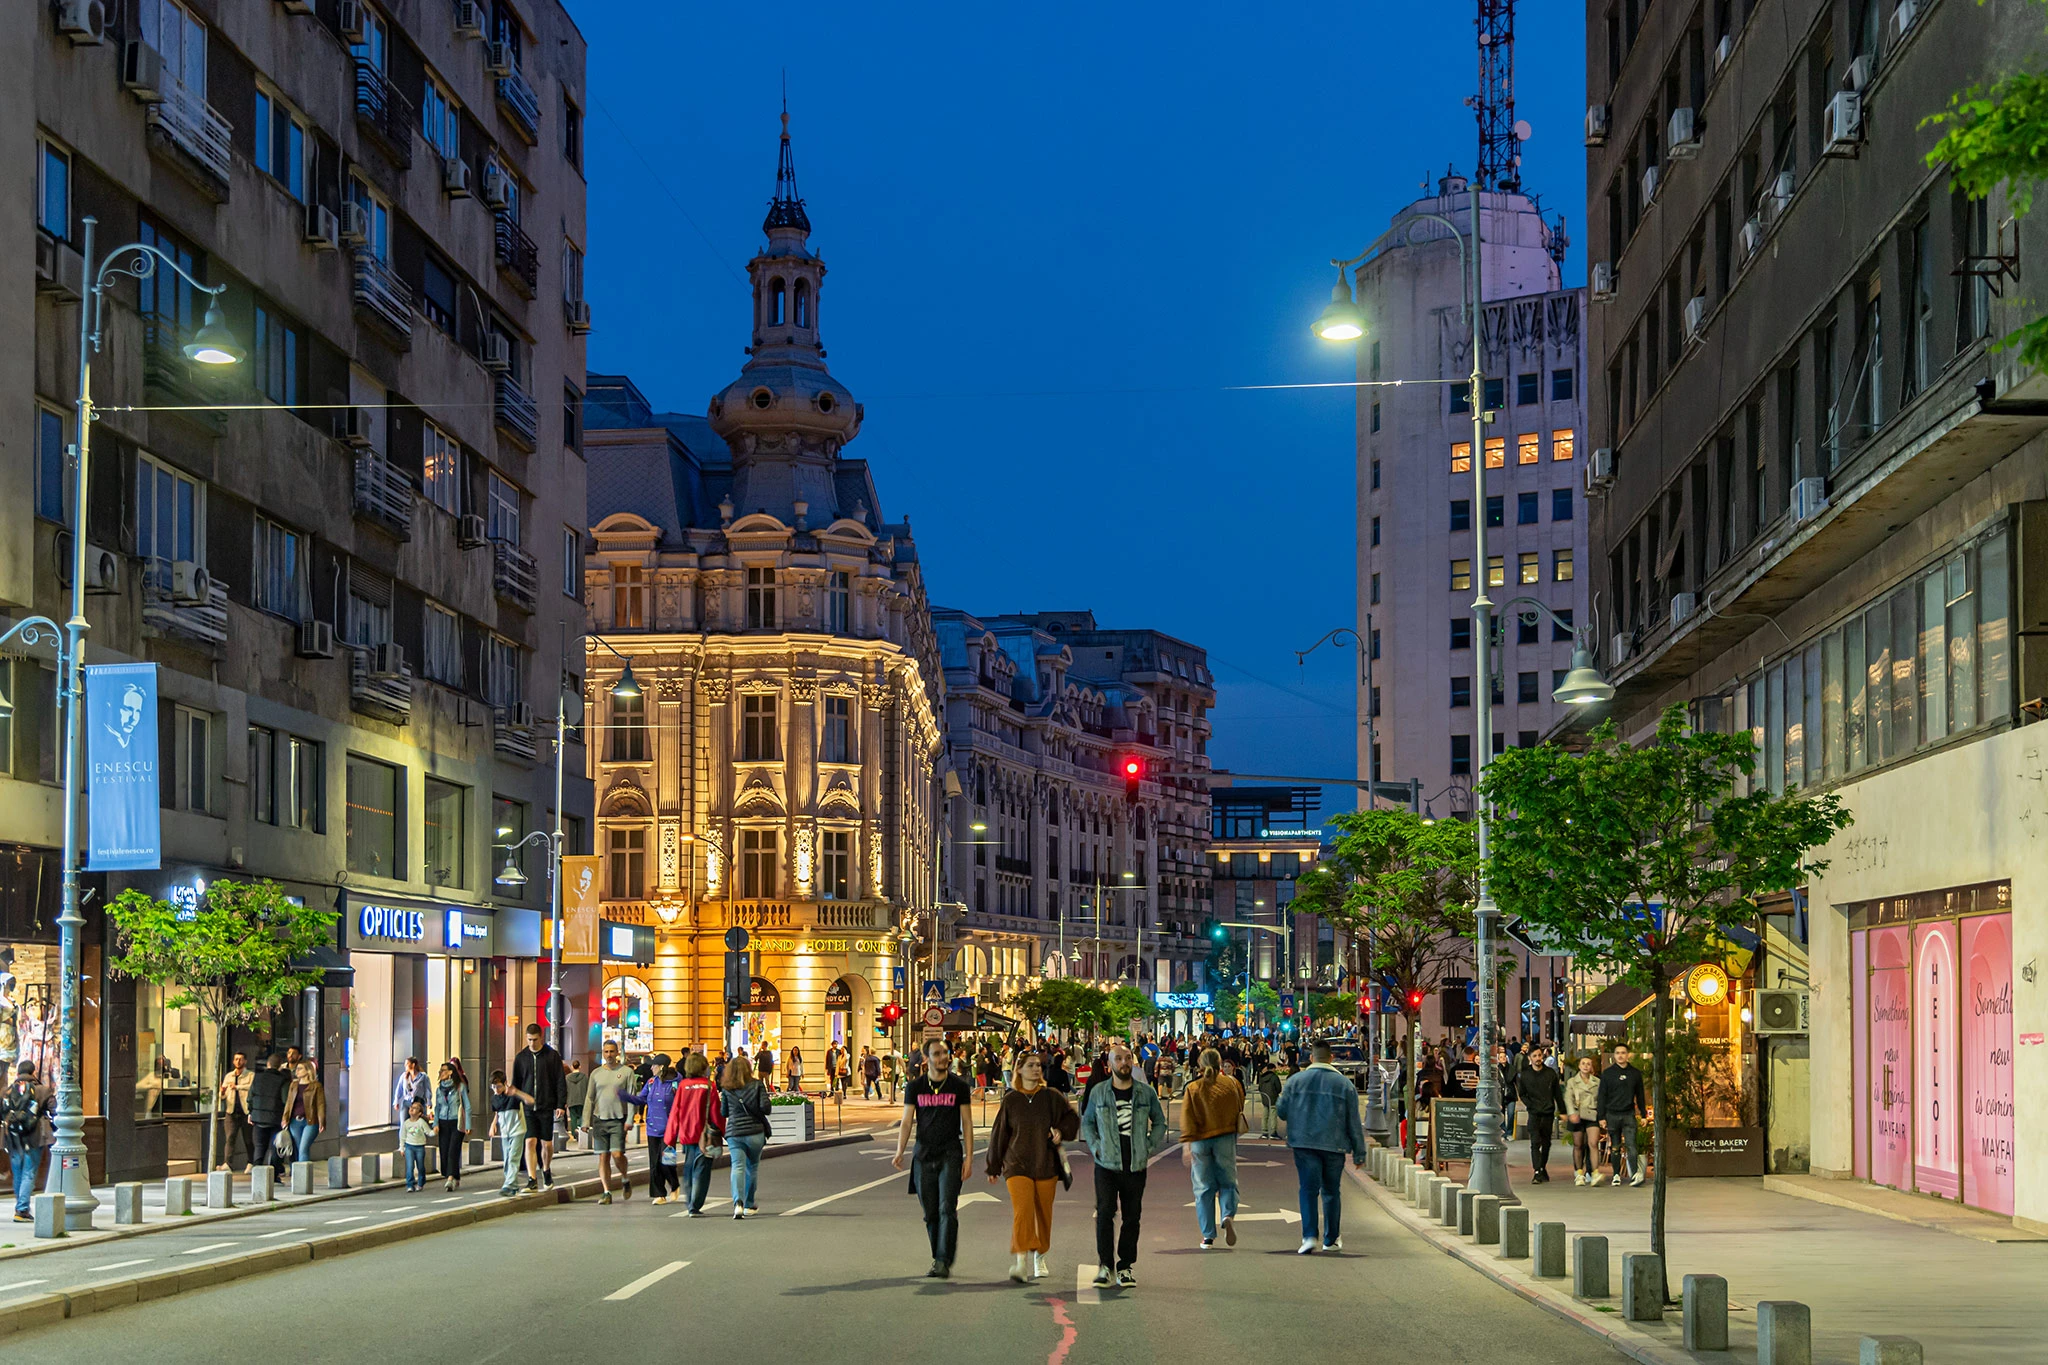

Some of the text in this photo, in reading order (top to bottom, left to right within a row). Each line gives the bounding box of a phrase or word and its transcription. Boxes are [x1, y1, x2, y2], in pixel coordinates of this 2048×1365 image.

[95, 761, 153, 774] ENESCU
[95, 774, 153, 784] FESTIVAL
[361, 905, 425, 940] OPTICLES
[805, 939, 851, 952] HOTEL
[1690, 968, 1725, 989] FRENCH BAKERY
[760, 995, 775, 1003] CAT
[1695, 994, 1720, 1003] COFFEE
[1873, 994, 1910, 1030] Something
[1884, 1047, 1899, 1063] new
[1989, 1048, 2010, 1066] new
[1873, 1081, 1880, 1102] is
[1974, 1090, 1984, 1115] is
[1878, 1119, 1907, 1141] MAYFAIR
[1685, 1138, 1749, 1148] FRENCH BAKERY
